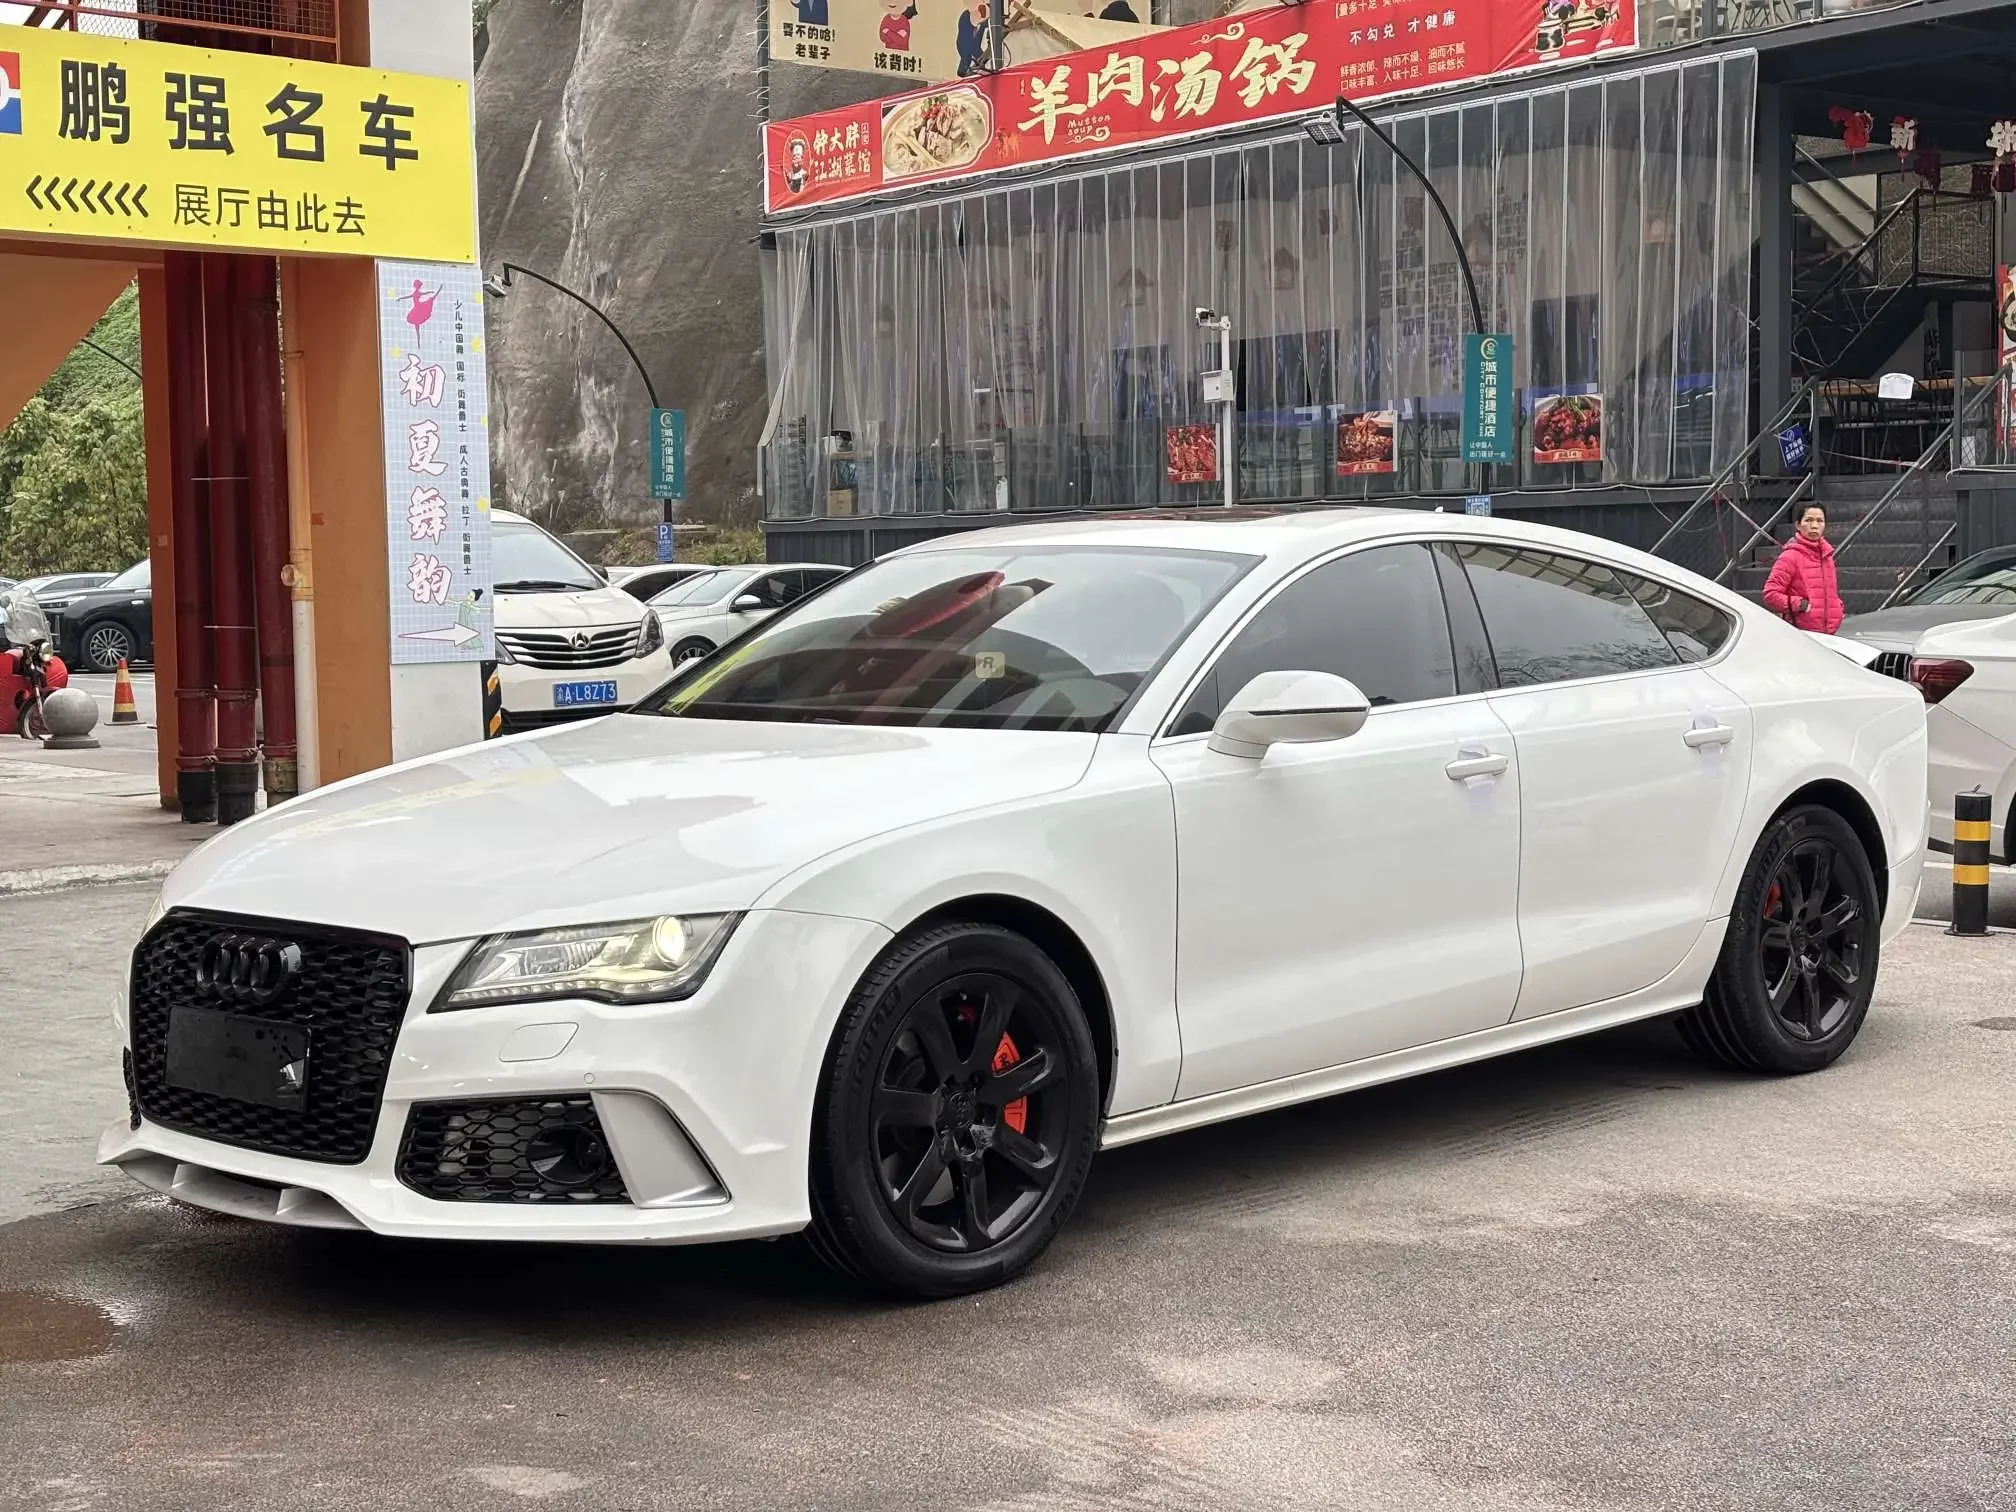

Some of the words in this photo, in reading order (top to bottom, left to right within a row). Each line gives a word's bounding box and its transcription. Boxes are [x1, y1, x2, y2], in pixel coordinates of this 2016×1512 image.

[1349, 23, 1396, 46] 不勾兑
[1407, 9, 1457, 33] 才健康
[795, 43, 831, 60] 老辈子
[874, 52, 922, 73] 该背时!
[1017, 32, 1317, 145] 羊肉汤锅
[58, 59, 419, 171] 鹏强名车
[1067, 114, 1112, 129] Mutton
[1067, 125, 1093, 136] soup
[813, 148, 872, 181] 江湖菜馆
[173, 183, 367, 237] 展厅由此去
[1484, 361, 1497, 438] 城市便捷酒店
[399, 353, 453, 605] 初夏舞韵
[659, 525, 669, 539] P
